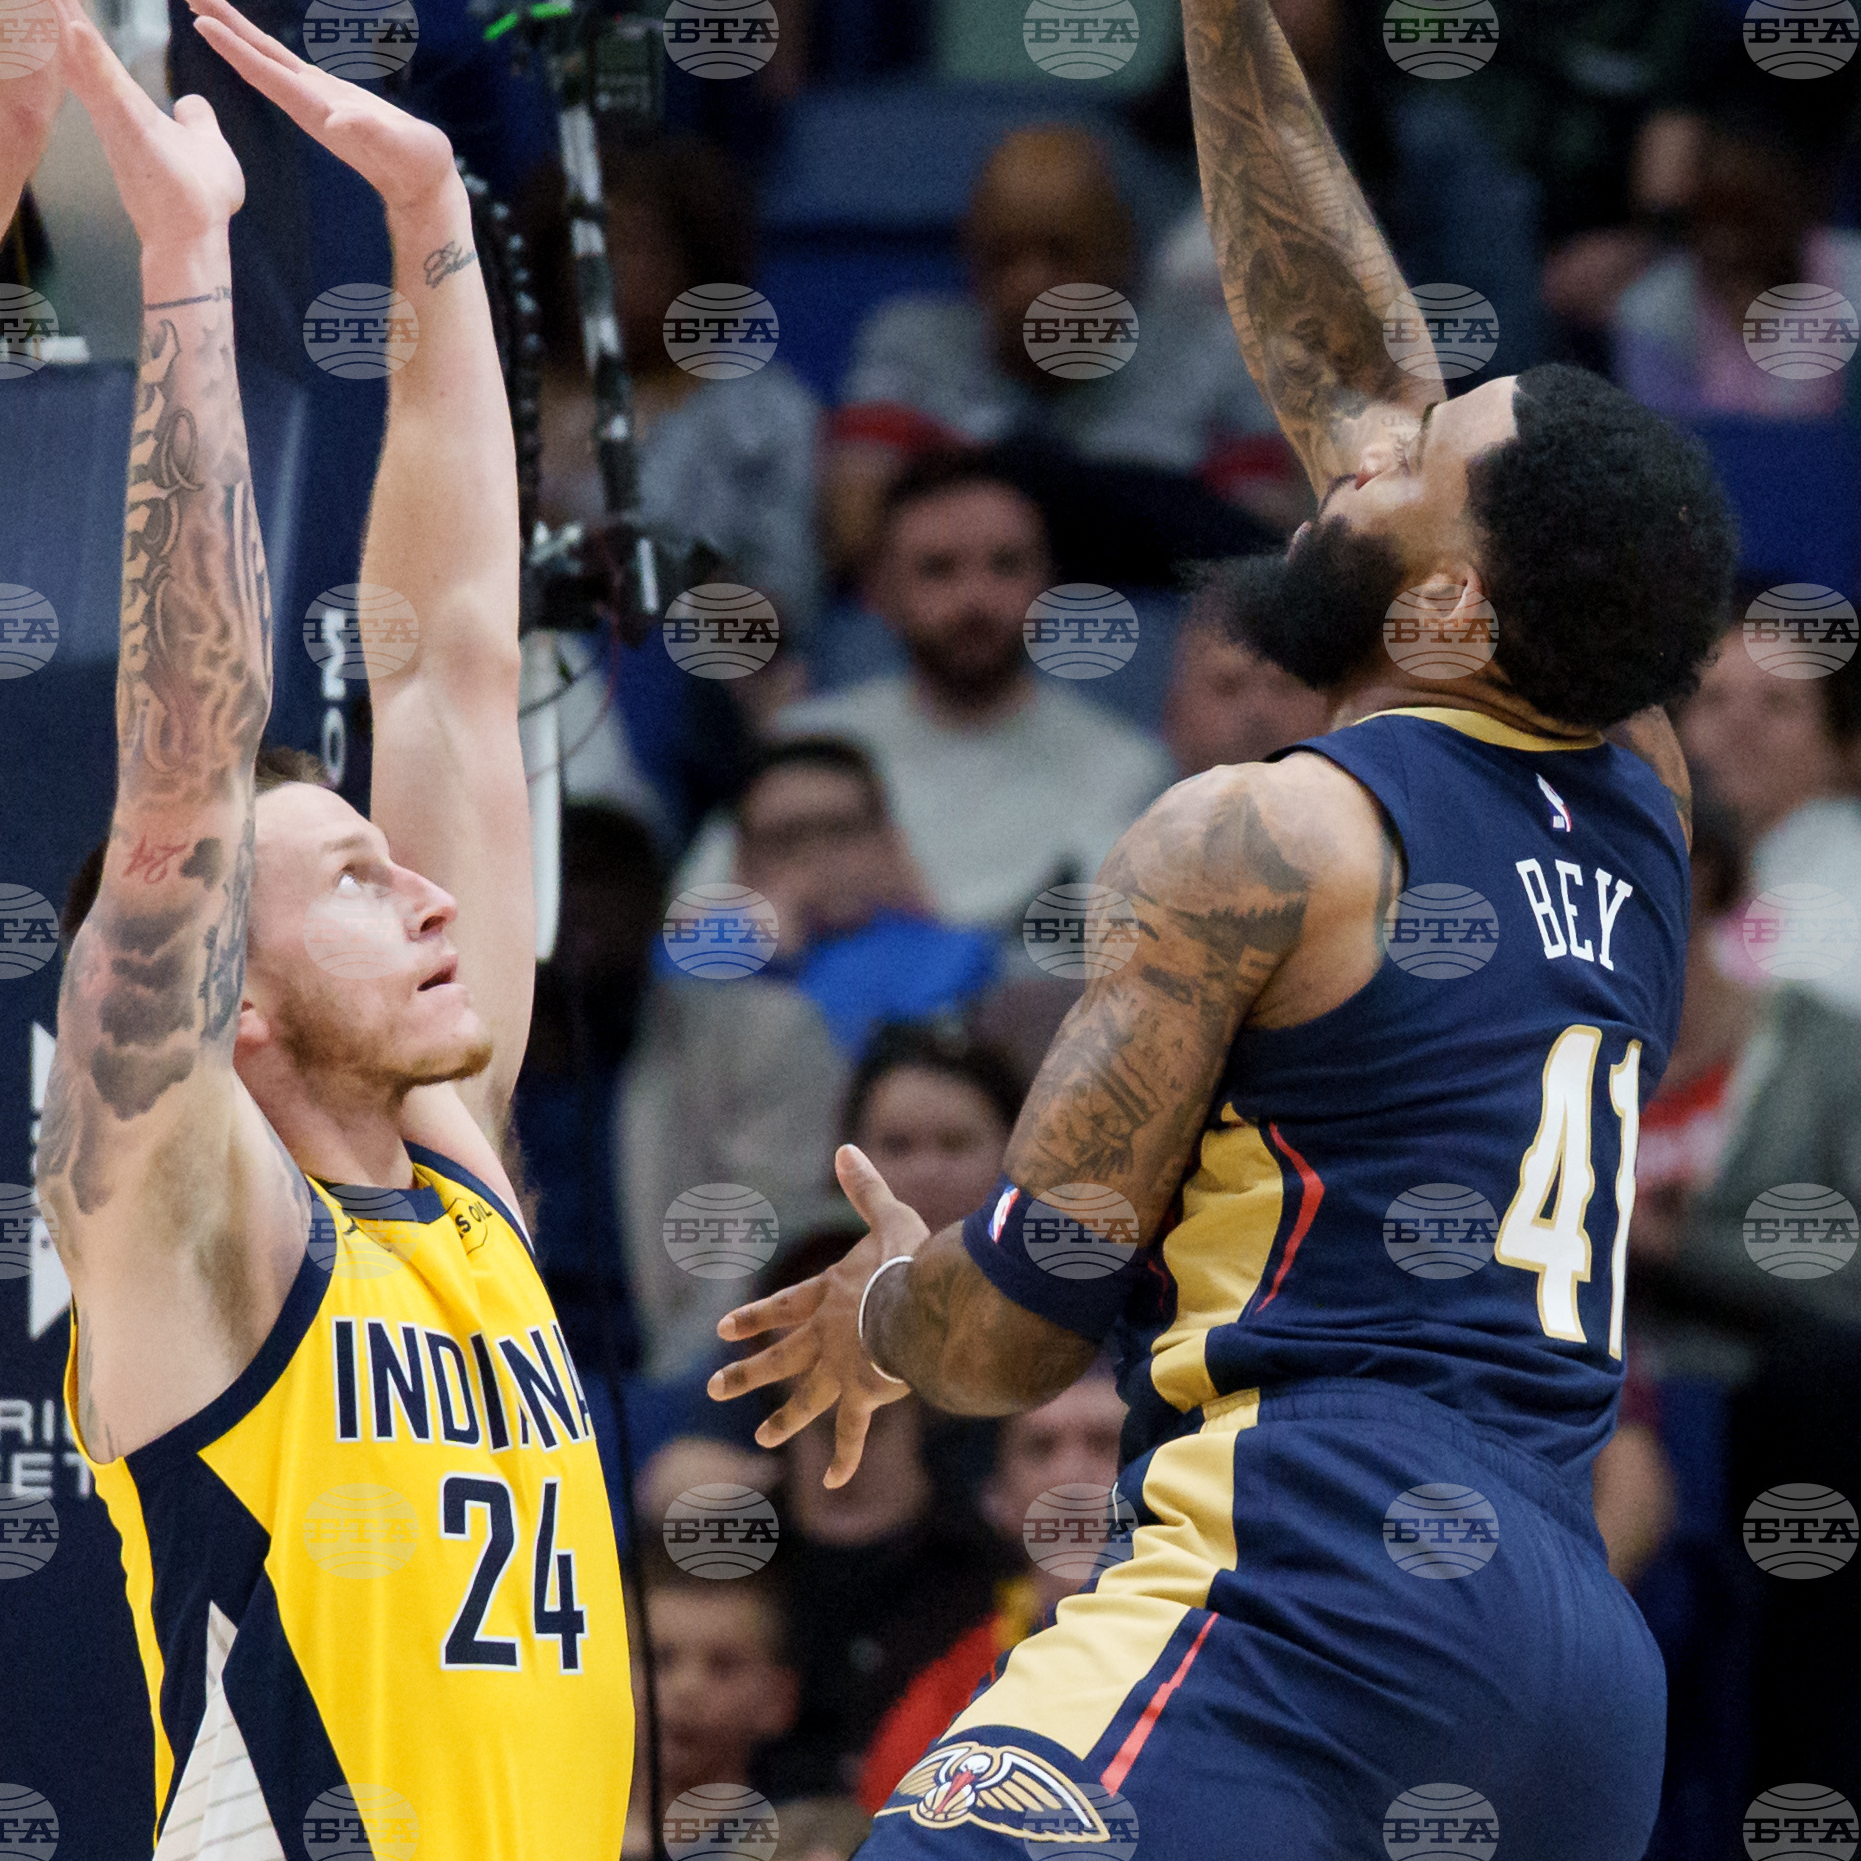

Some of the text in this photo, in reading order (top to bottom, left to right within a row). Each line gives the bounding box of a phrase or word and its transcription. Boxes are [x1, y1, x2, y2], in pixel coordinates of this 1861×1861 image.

[1515, 857, 1633, 971] BEY
[1494, 1024, 1643, 1362] 41
[439, 1471, 590, 1676] 24
